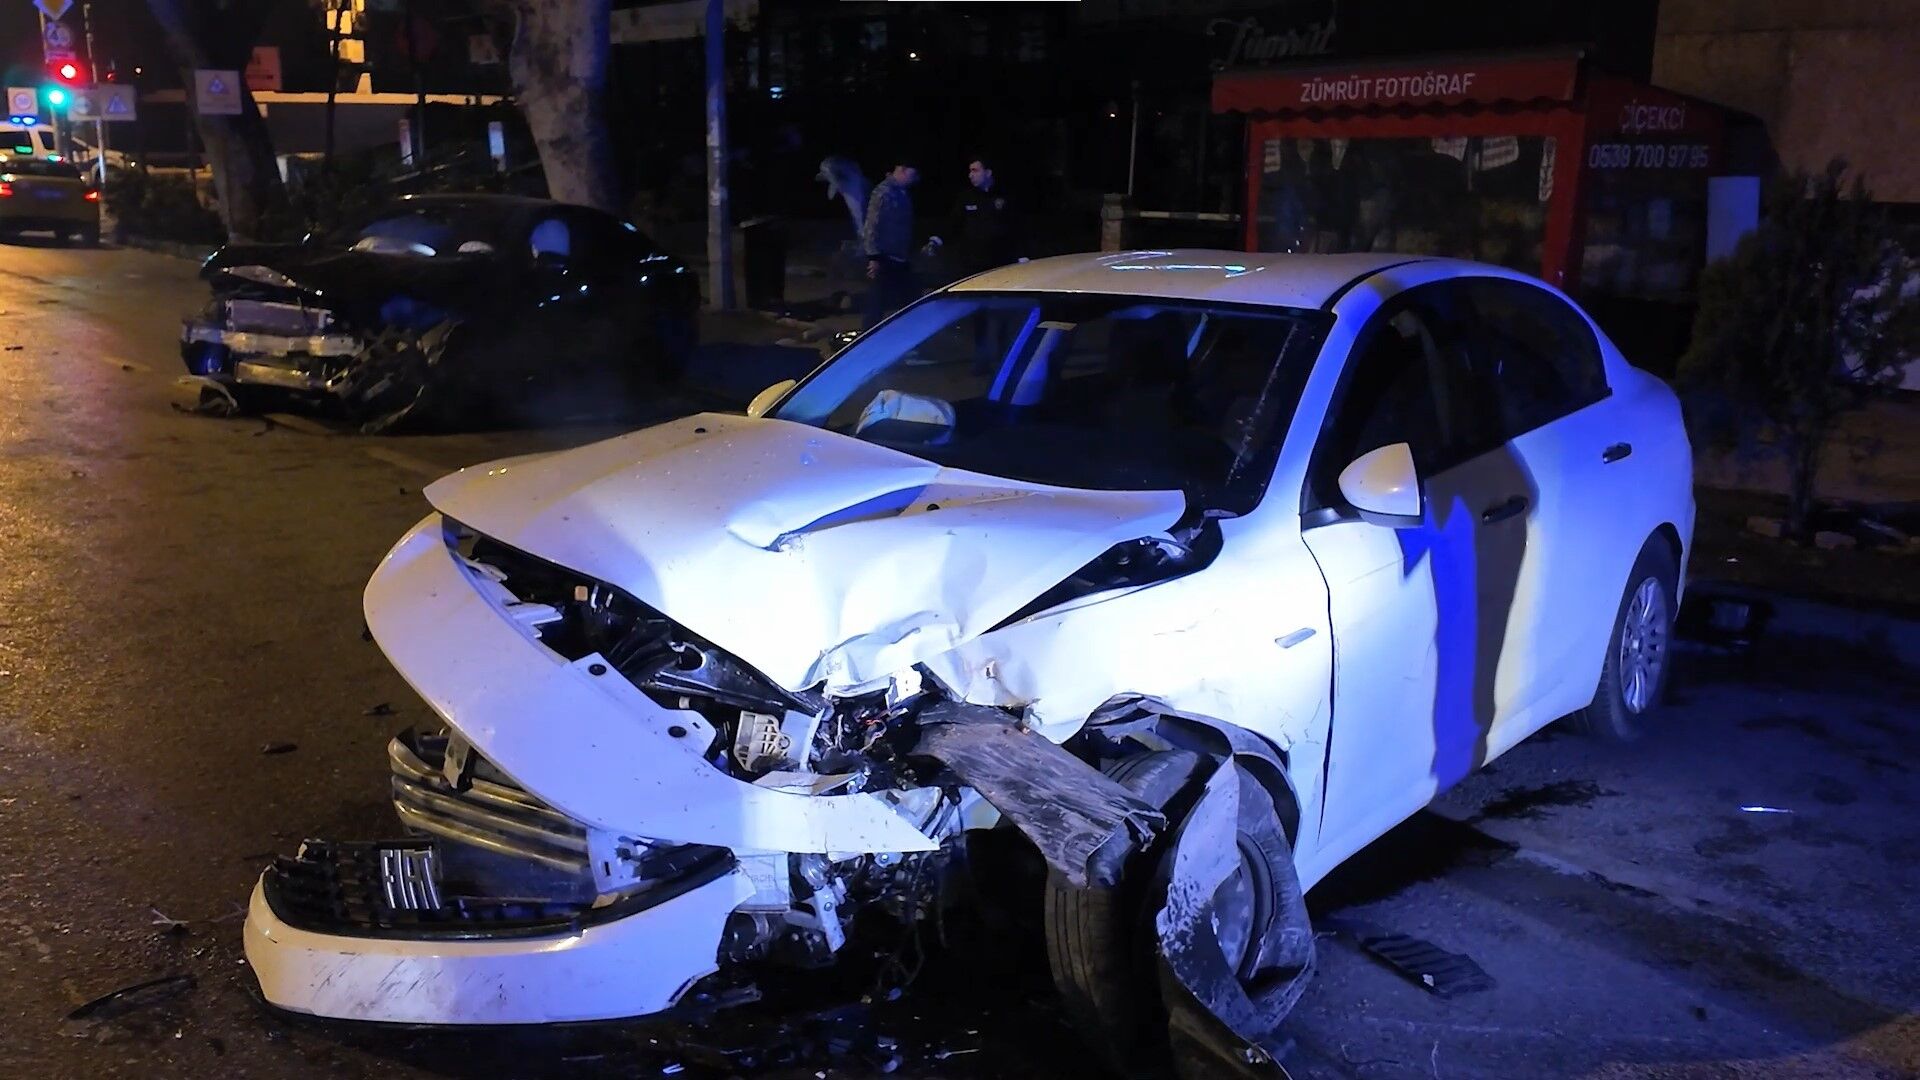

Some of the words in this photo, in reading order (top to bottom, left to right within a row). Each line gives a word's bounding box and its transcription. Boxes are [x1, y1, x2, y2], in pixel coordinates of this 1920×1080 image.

[1300, 75, 1371, 102] ZÜMRÜT
[1374, 71, 1475, 98] FOTOĞRAF
[1634, 144, 1665, 168] 700
[380, 847, 440, 910] FIAT
